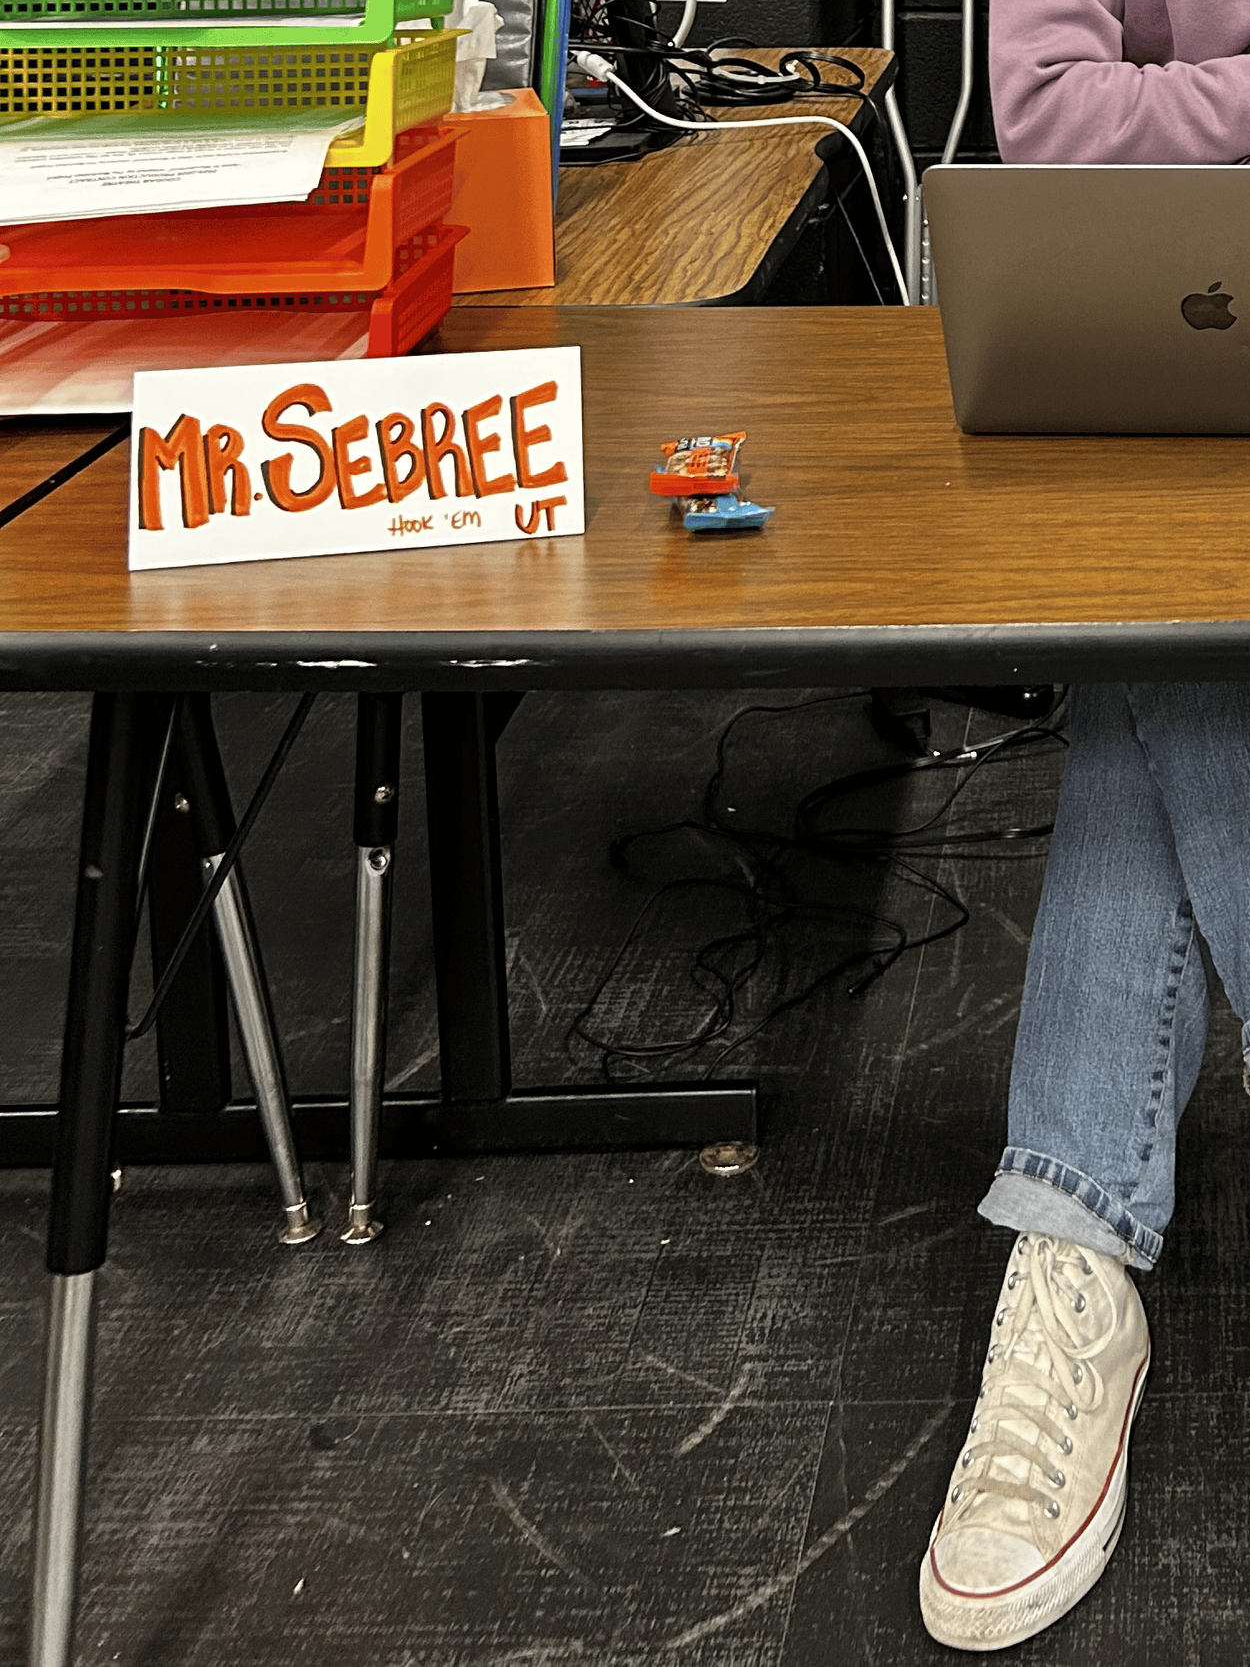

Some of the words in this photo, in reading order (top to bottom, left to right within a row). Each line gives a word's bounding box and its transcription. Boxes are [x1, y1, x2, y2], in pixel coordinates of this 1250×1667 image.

[138, 413, 264, 531] MR.
[260, 380, 569, 513] SEBREE
[514, 496, 568, 535] UT
